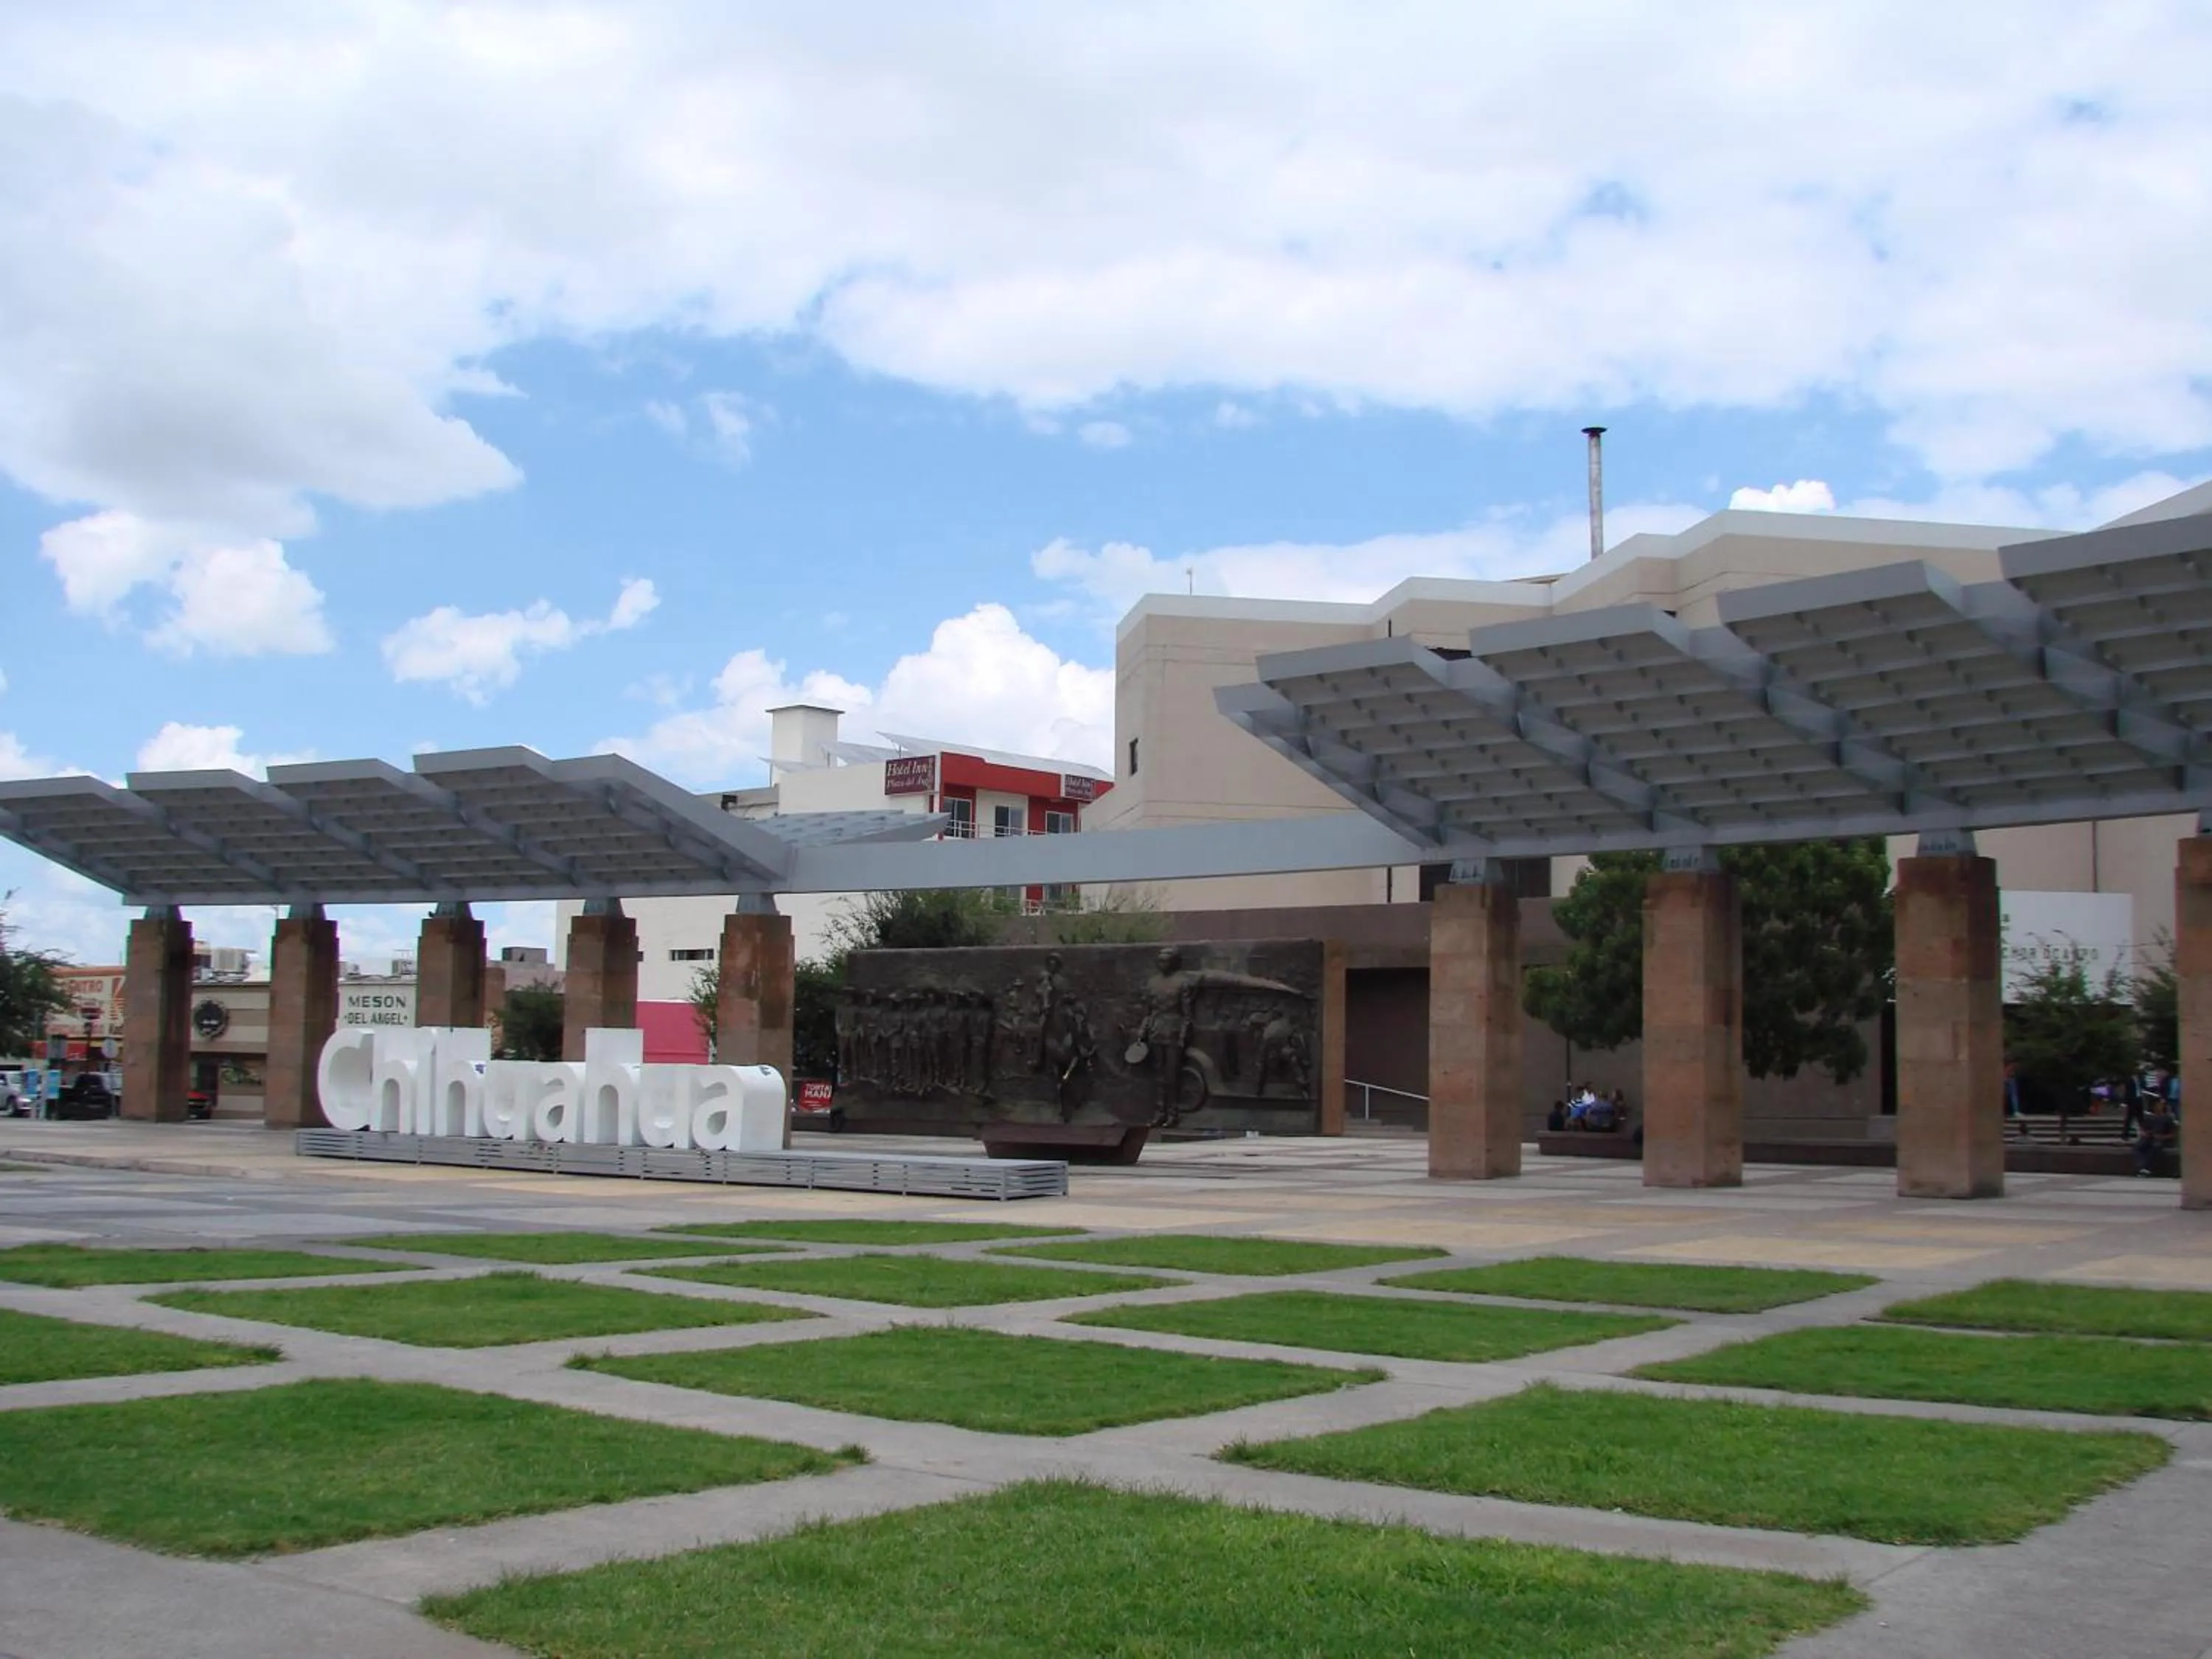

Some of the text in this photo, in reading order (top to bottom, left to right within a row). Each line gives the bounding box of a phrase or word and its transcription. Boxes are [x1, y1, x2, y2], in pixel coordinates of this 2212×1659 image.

[887, 760, 911, 776] Hotel
[912, 760, 927, 773] Inn
[348, 995, 406, 1008] MESON
[347, 1012, 403, 1025] DEL ANGEL
[319, 1026, 786, 1150] Chihuahua
